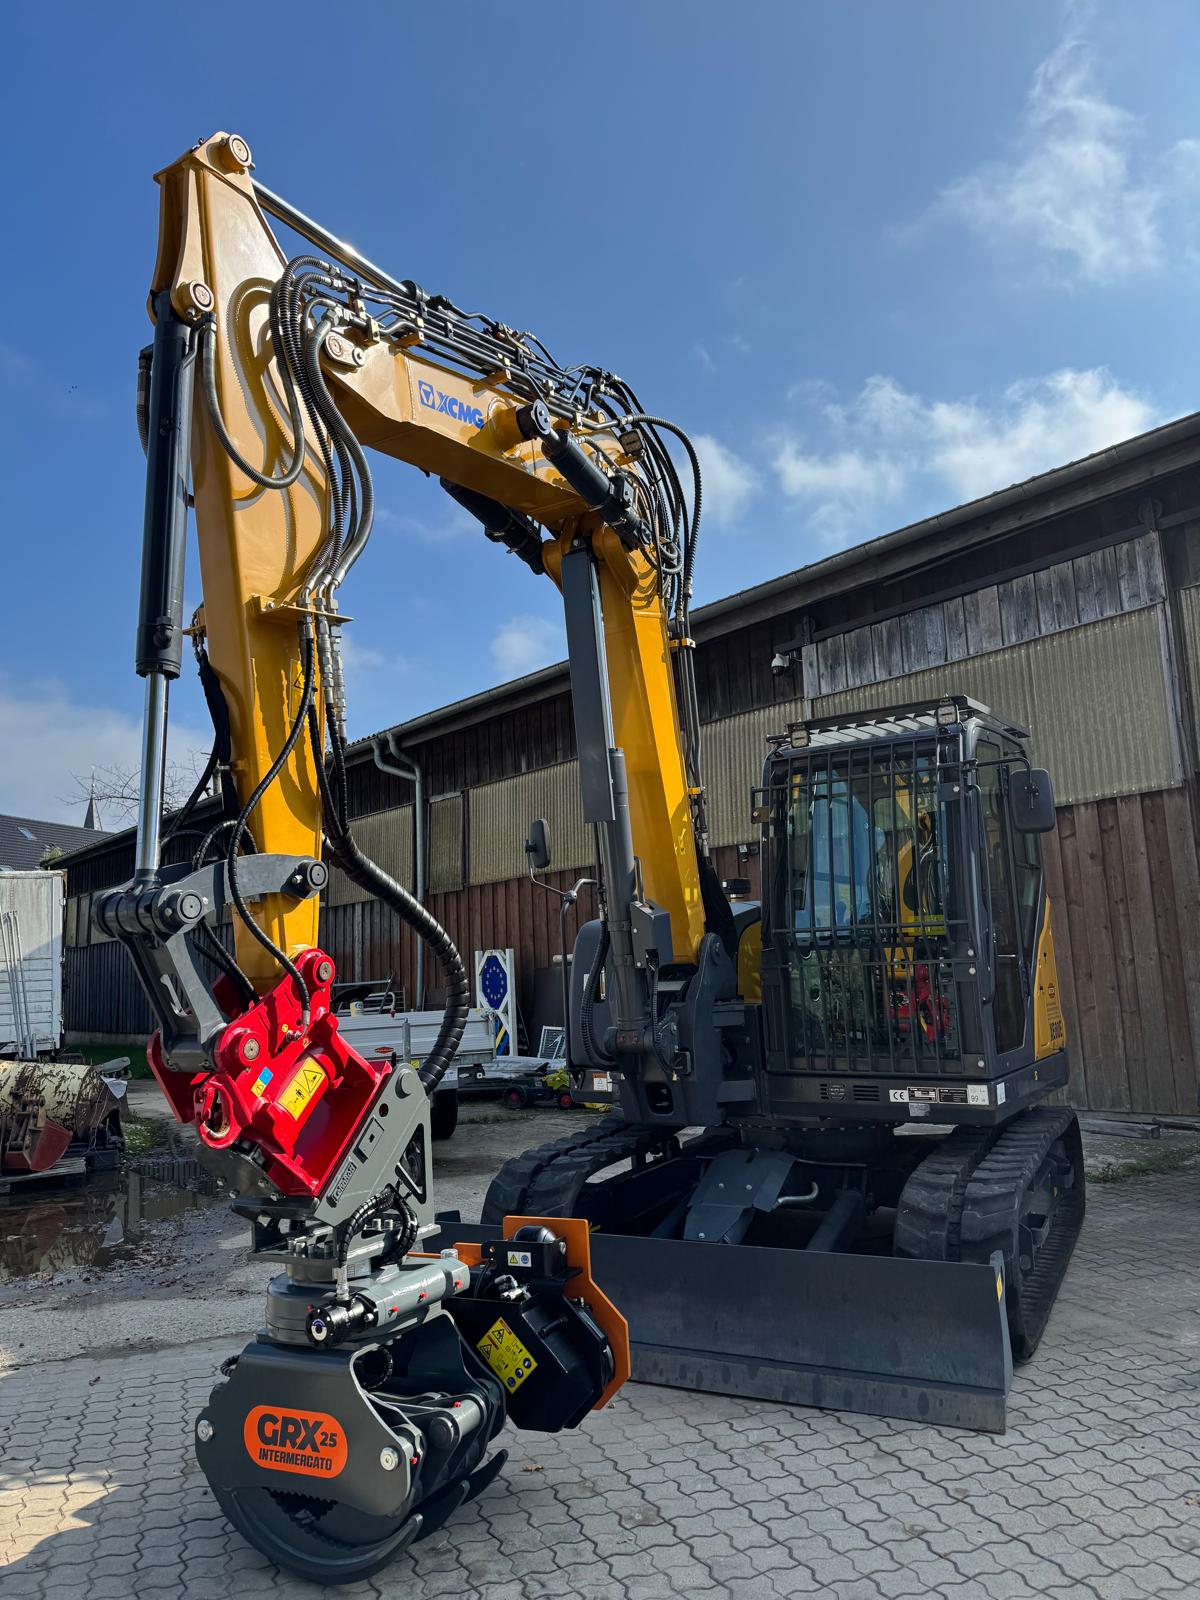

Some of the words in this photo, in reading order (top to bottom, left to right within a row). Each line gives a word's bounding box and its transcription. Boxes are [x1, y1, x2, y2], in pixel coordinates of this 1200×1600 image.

[437, 391, 484, 429] XCMG
[257, 1413, 323, 1453] GRX
[320, 1432, 337, 1448] 25
[258, 1448, 333, 1471] INTERMERCATO
